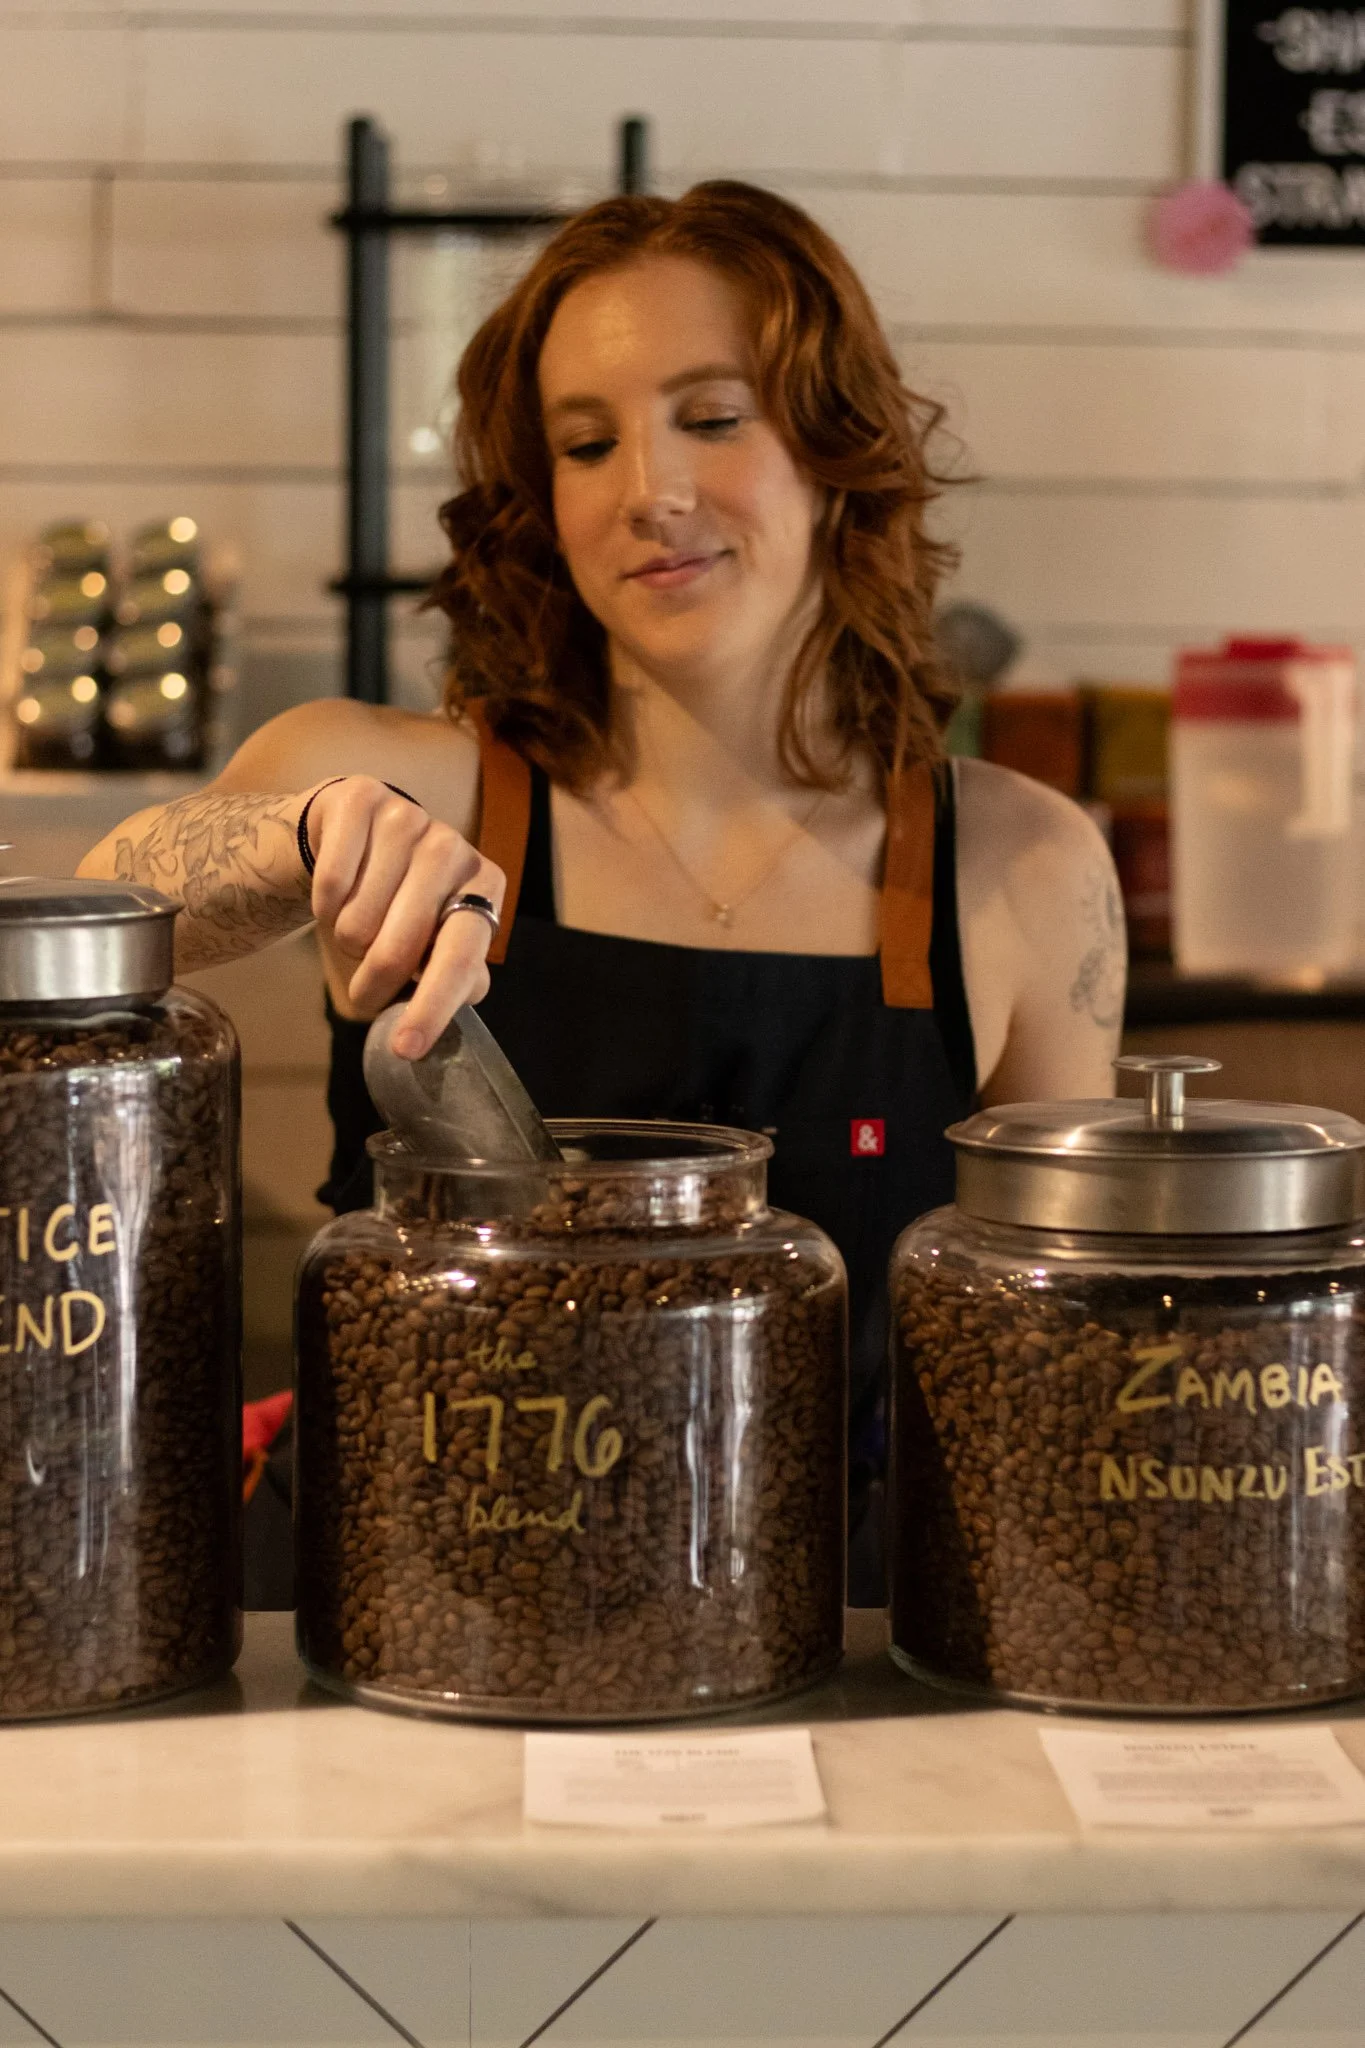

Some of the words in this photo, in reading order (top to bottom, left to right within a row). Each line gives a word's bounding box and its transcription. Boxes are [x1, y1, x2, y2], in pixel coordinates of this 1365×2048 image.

[465, 1338, 537, 1372] the
[1116, 1344, 1343, 1415] ZAMBIA
[423, 1391, 623, 1478] 1776
[467, 1488, 586, 1536] blend
